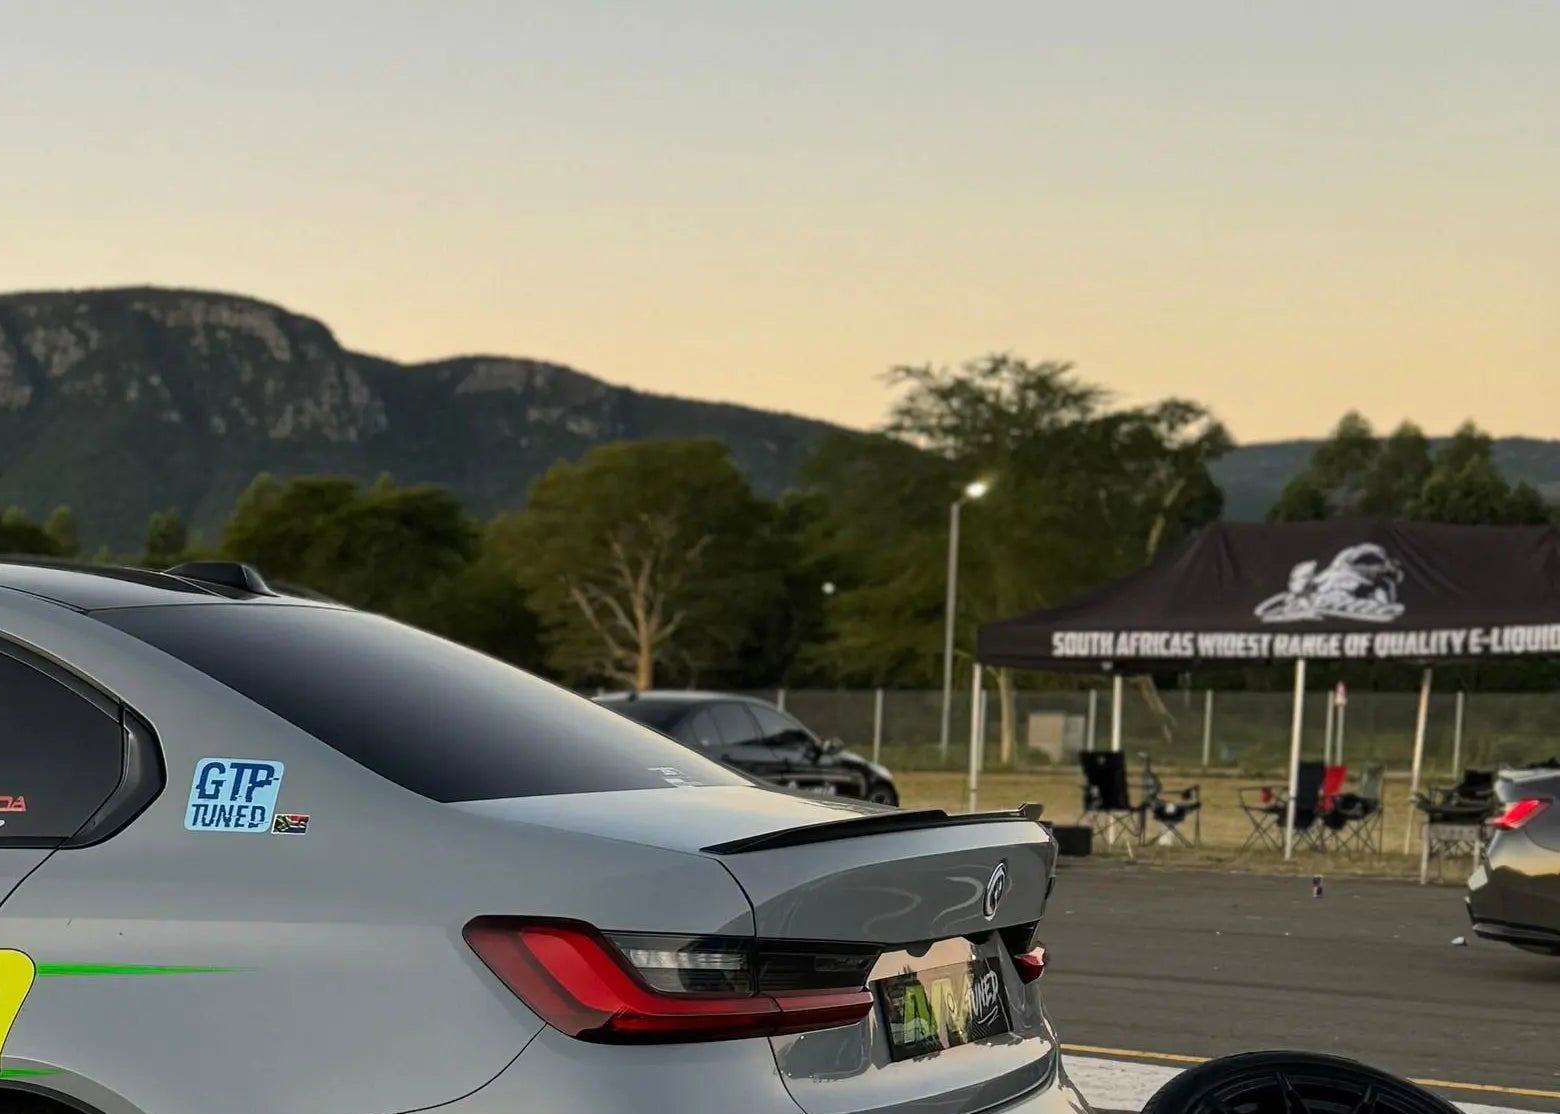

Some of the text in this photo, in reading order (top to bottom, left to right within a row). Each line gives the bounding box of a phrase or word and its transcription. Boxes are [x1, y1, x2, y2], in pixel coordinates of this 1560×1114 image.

[1052, 632, 1114, 657] SOUTH
[1116, 632, 1194, 657] AFRICAS
[1197, 633, 1272, 658] WIDEST
[1273, 634, 1341, 657] RANGE
[1344, 633, 1372, 656] OF
[1374, 629, 1466, 656] QUALITY
[196, 762, 280, 803] GTP
[191, 803, 268, 829] TUNED
